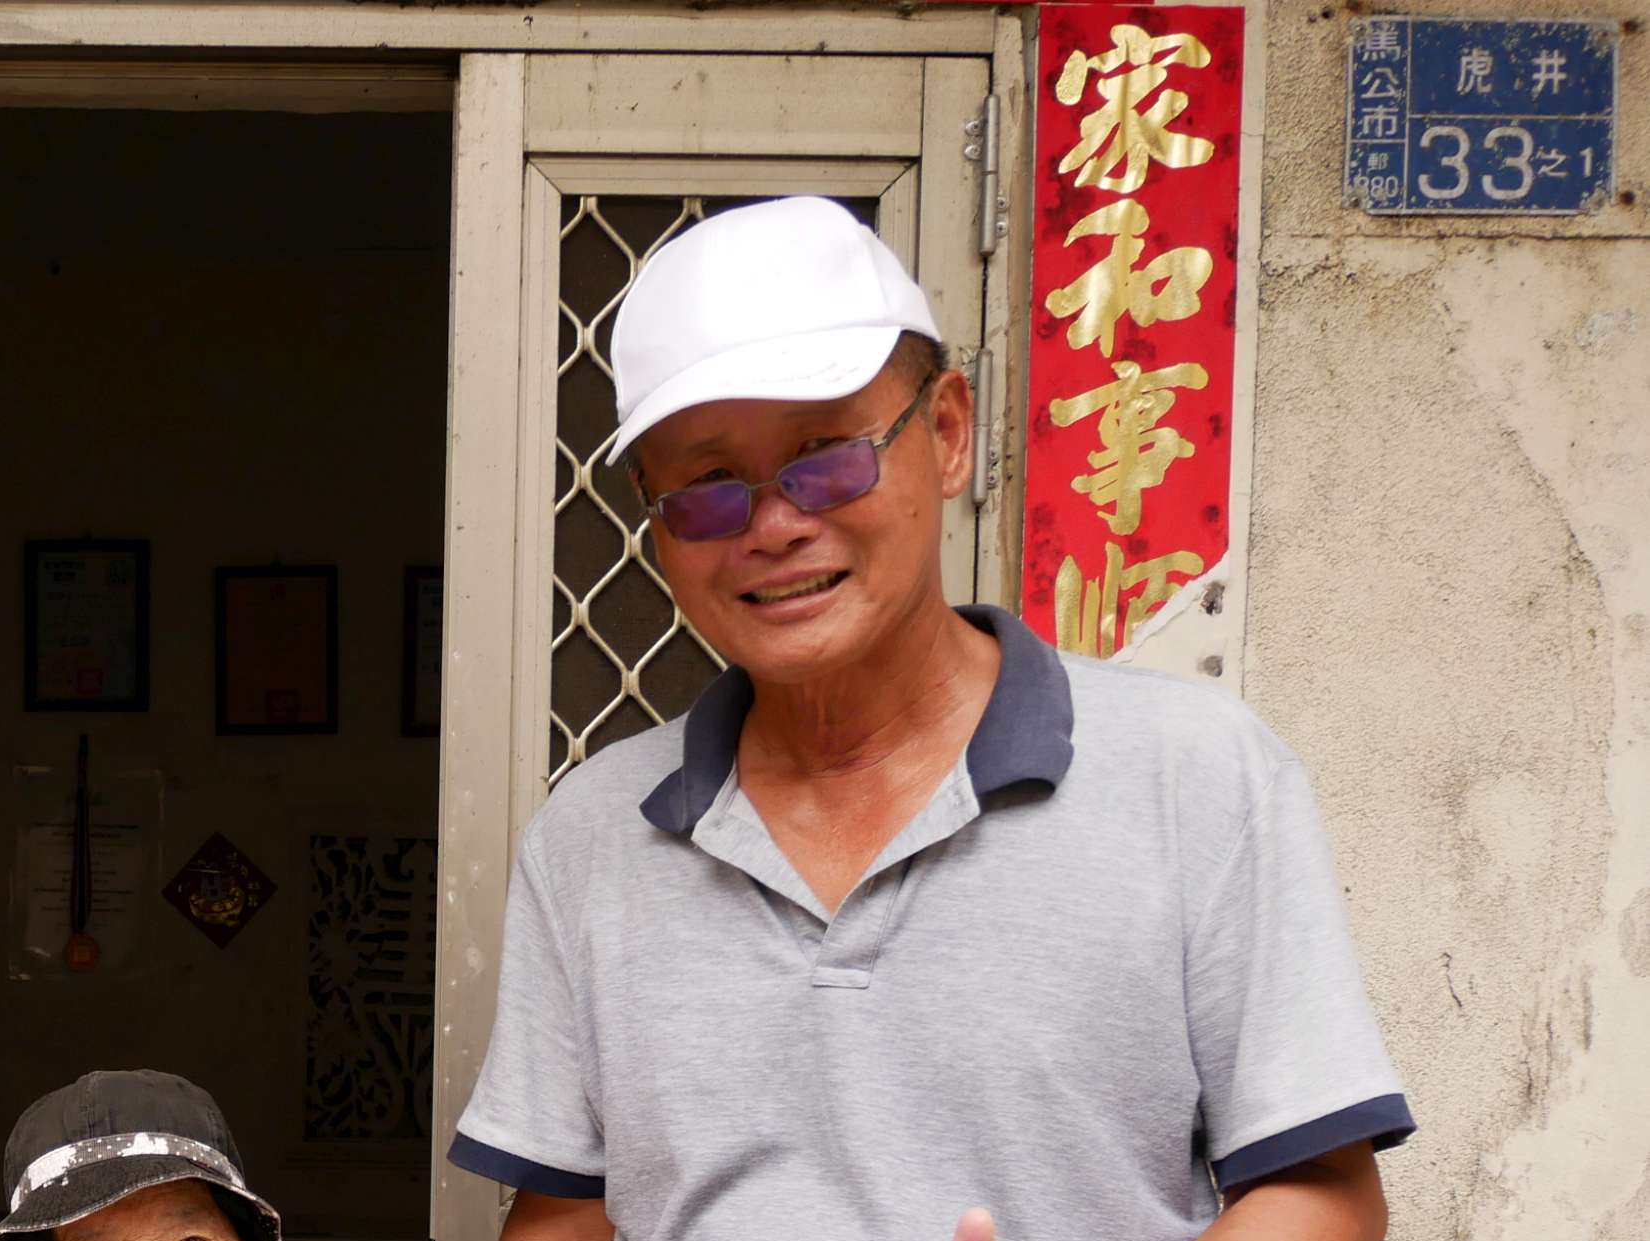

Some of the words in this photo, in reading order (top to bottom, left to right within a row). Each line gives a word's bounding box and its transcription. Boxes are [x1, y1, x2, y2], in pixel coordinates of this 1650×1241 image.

[1361, 22, 1401, 138] 馬公市
[1456, 47, 1567, 98] 虎井
[1418, 125, 1594, 200] 33之1
